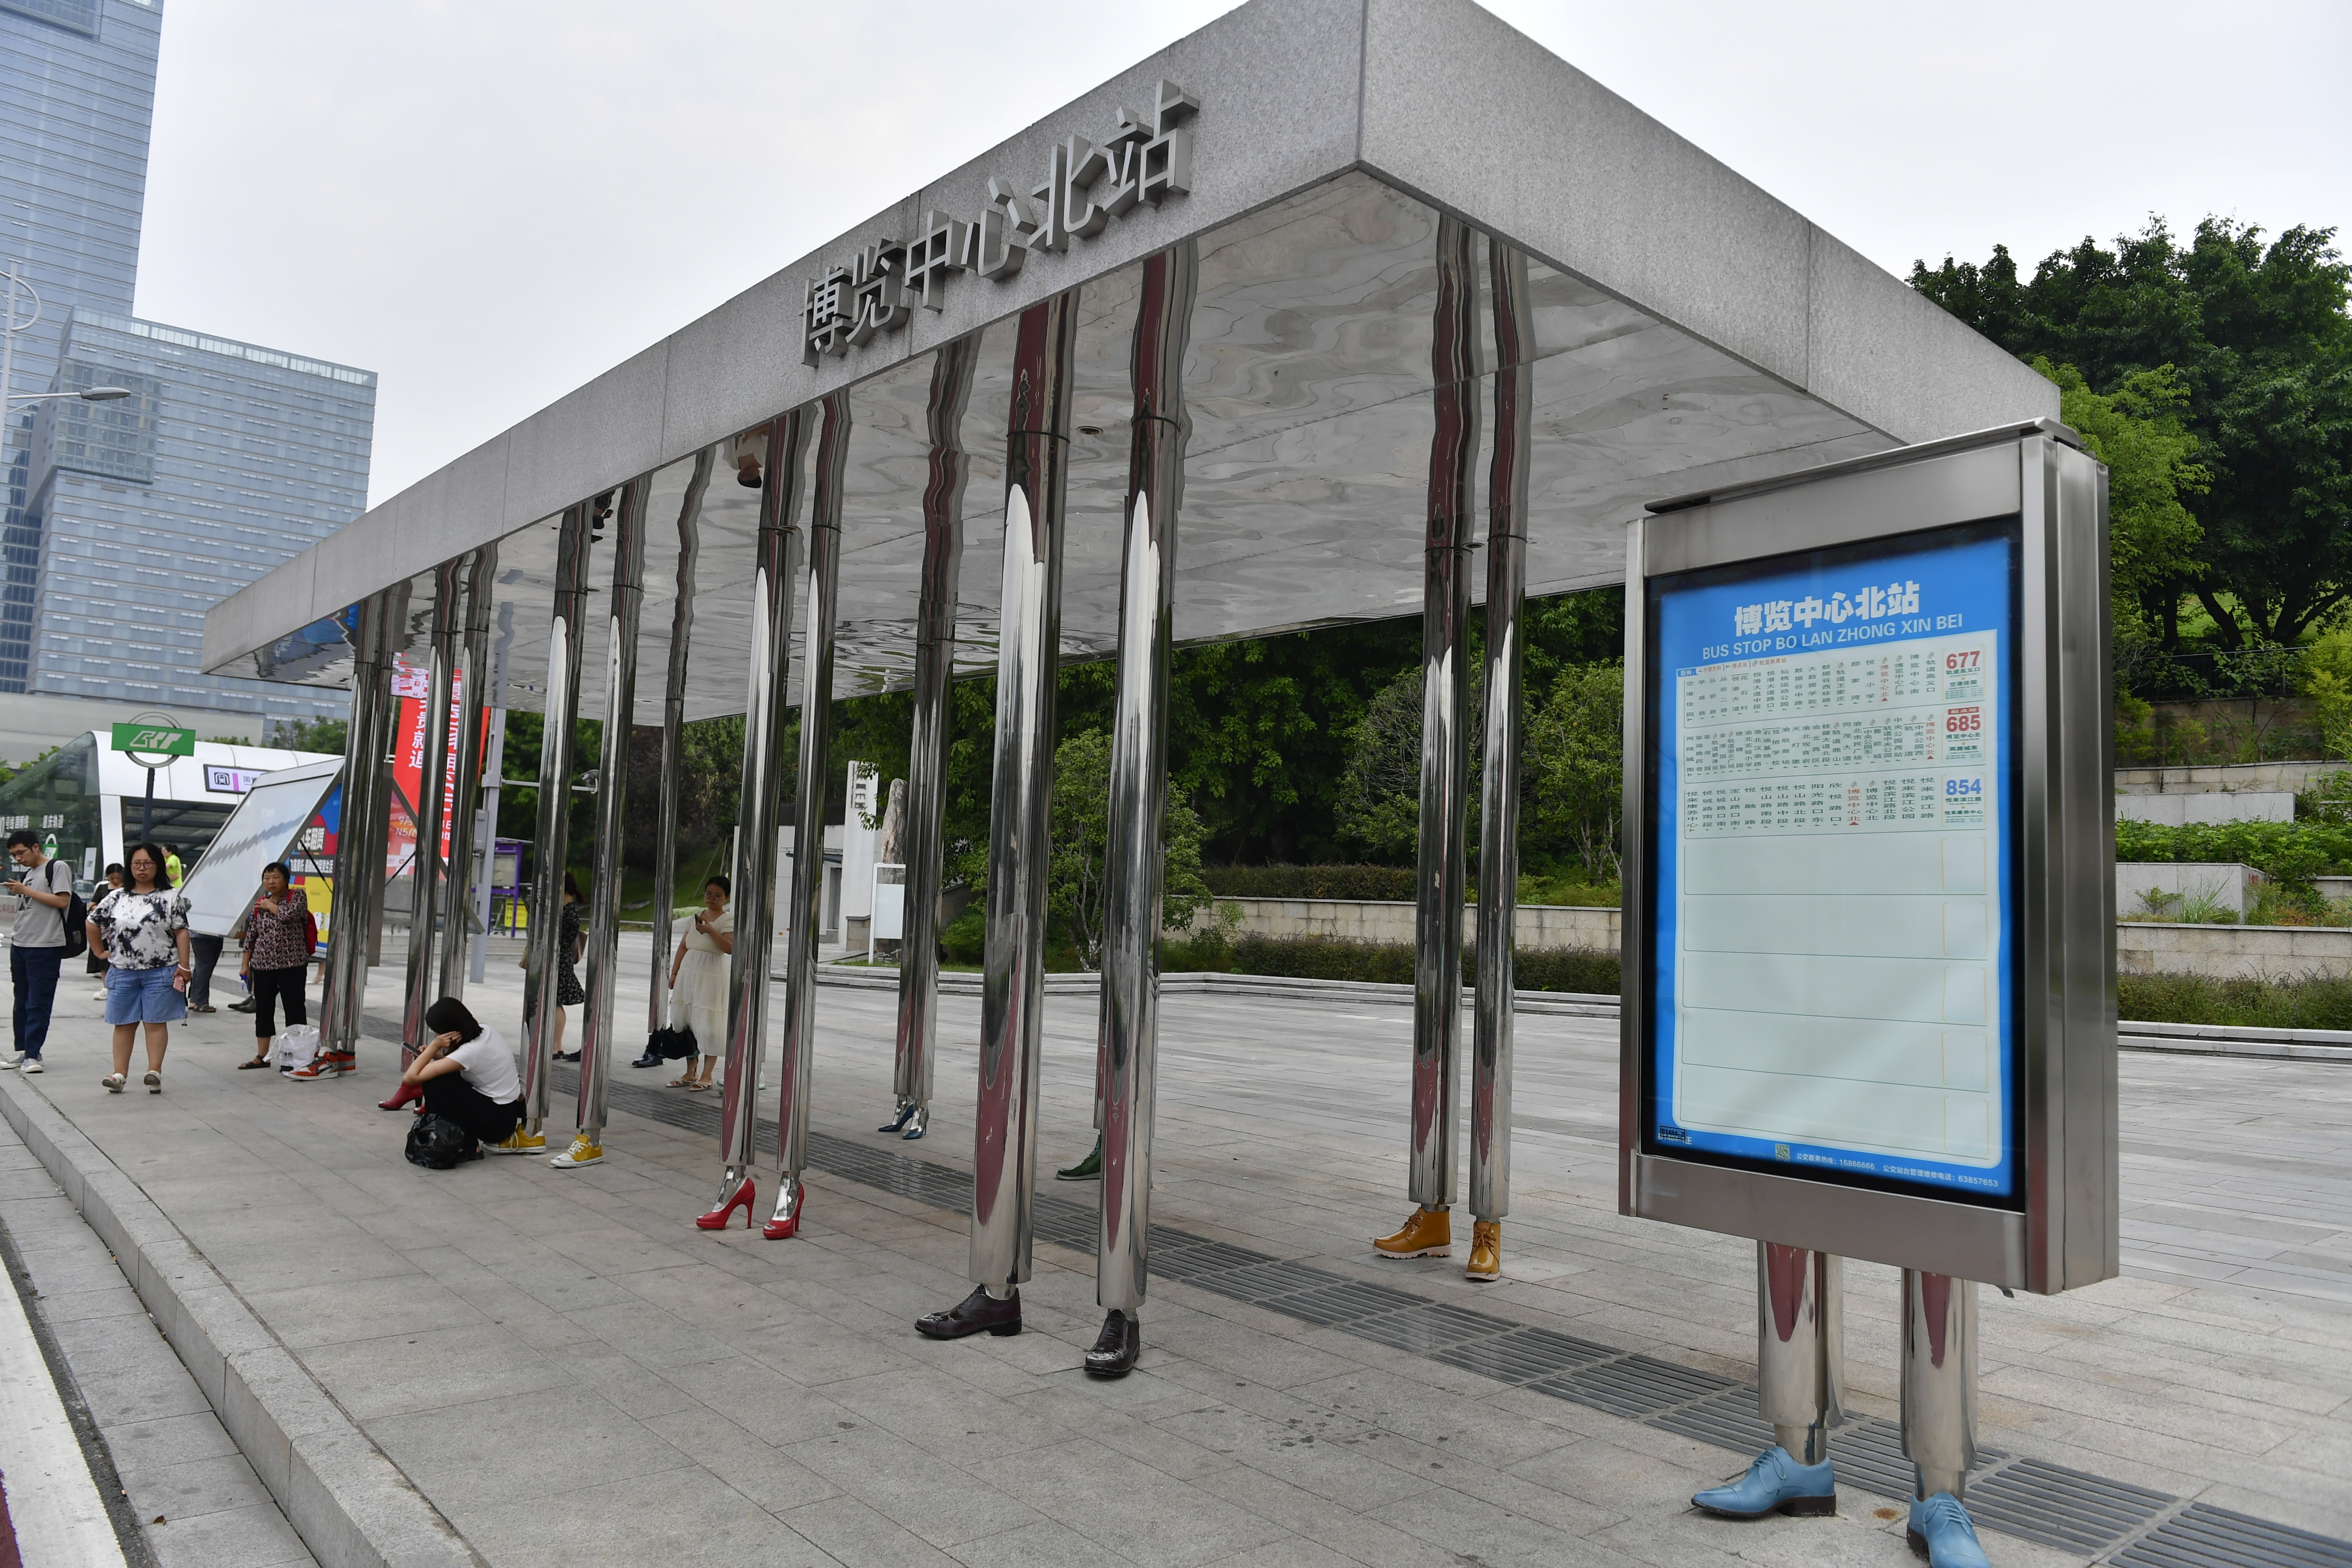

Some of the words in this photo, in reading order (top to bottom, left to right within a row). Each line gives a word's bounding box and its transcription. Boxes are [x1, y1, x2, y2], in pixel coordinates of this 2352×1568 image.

[799, 78, 1200, 368] 博览中心北站
[1734, 580, 1919, 637] 博览中心北站
[1703, 644, 1729, 660] BUS
[1733, 639, 1772, 655] STOP
[1776, 636, 1797, 650] BO
[1802, 631, 1832, 647] LAN
[1838, 622, 1895, 642] ZHONG
[1901, 618, 1931, 634] XIN
[1937, 613, 1963, 630] BEI
[1759, 657, 1787, 666] 轨道换乘站
[1910, 654, 1919, 694] 博览中心南
[1926, 660, 1936, 692] 轨道高义口
[1946, 651, 1980, 669] 677
[1946, 667, 1980, 675] 轨道高义口
[1753, 672, 1761, 709] 悦港大道中段
[1767, 671, 1775, 708] 悦港大道路口
[1780, 670, 1789, 706] 仙桃运动公园
[1795, 668, 1803, 705] 数据谷中路
[1808, 666, 1816, 704] 大数据学院
[1822, 664, 1831, 703] 数据谷西环路
[1836, 670, 1845, 702] 轨道王家庄
[1851, 661, 1860, 700] 颜家湾
[1866, 659, 1875, 699] 悦来小学
[1881, 665, 1889, 697] 博览中心北
[1895, 663, 1904, 695] 博览中心广场
[1843, 722, 1851, 761] 同茂大道
[1853, 721, 1862, 760] 渝北市民广场
[1894, 718, 1903, 757] 中央公园西站
[1915, 725, 1924, 755] 中央公园西
[1926, 722, 1935, 755] 博览中心北
[1946, 714, 1981, 732] 685
[1745, 730, 1753, 767] 渝北实验小学
[1792, 727, 1800, 763] 天灯堡
[1802, 726, 1810, 763] 渝北观音岩
[1812, 724, 1820, 762] 渝北西区
[1832, 730, 1841, 761] 轨道鹿山
[1873, 729, 1882, 759] 鲁能城
[1884, 726, 1892, 758] 轨道中央公园
[1760, 787, 1772, 824] 悦山路南段
[1776, 785, 1789, 824] 悦山路中段
[1794, 784, 1806, 823] 悦山路北段
[1811, 784, 1824, 822] 阳光路口东
[1829, 783, 1842, 822] 欣悦路口
[1847, 789, 1861, 821] 博览中心北
[1865, 788, 1879, 821] 博览中心北
[1883, 779, 1897, 819] 悦来滨江路北段
[1902, 779, 1915, 819] 悦来滨江公园
[1920, 777, 1935, 818] 悦来滨江路
[1946, 779, 1982, 795] 854
[1686, 792, 1699, 827] 悦来康养中心
[1702, 790, 1713, 827] 悦城路南段
[1716, 789, 1726, 826] 悦城路口南
[1730, 789, 1740, 826] 宝山路口南
[1744, 787, 1756, 825] 悦融路
[1661, 1129, 1684, 1137] B1484-2
